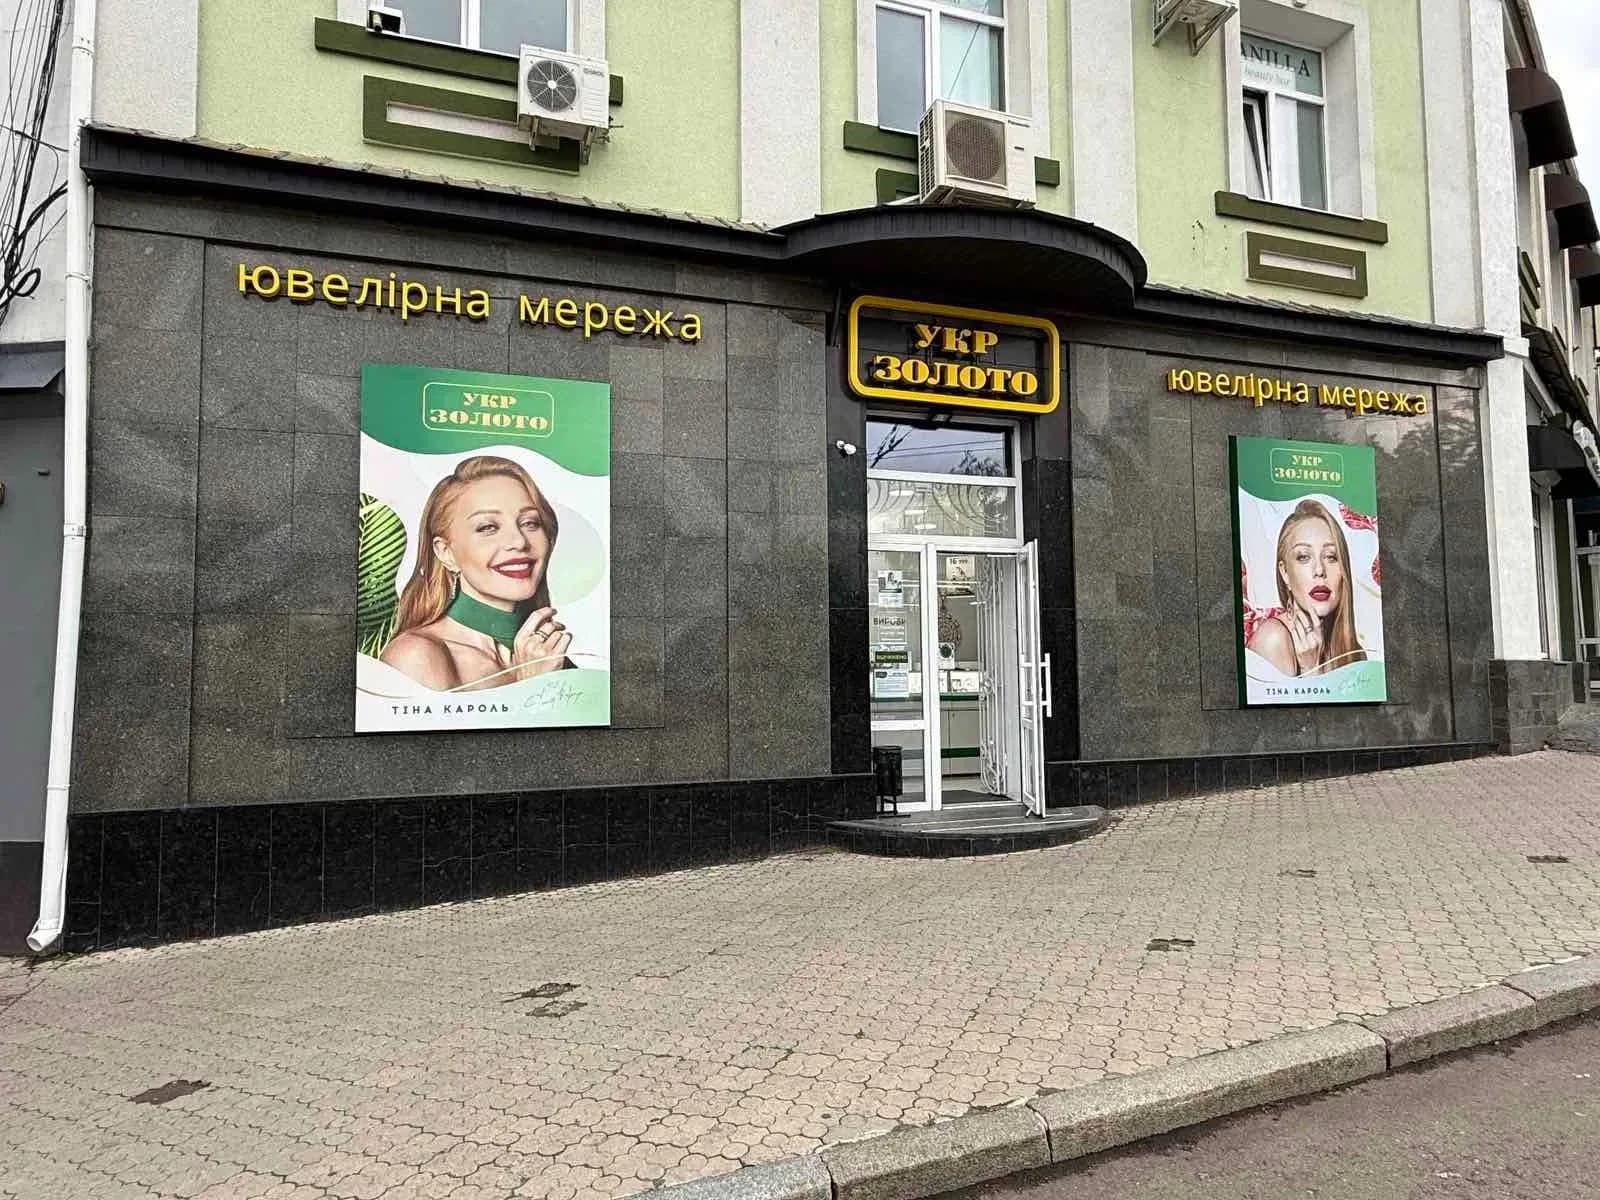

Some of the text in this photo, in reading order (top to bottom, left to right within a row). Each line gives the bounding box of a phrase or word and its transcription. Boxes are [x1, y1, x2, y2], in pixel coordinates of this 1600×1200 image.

[237, 262, 702, 342] ювелірна мережа
[914, 322, 999, 354] УКР
[873, 355, 1039, 395] ЗОЛОТО
[463, 392, 518, 409] УКР
[1167, 368, 1428, 416] ювелірна мережа
[429, 409, 549, 430] ЗОЛОТО
[1291, 454, 1323, 466] УКР
[1274, 467, 1341, 481] ЗОЛОТО
[1294, 687, 1331, 695] КАРОЛЬ
[391, 703, 510, 715] ТІНА КАРОЛЬ
